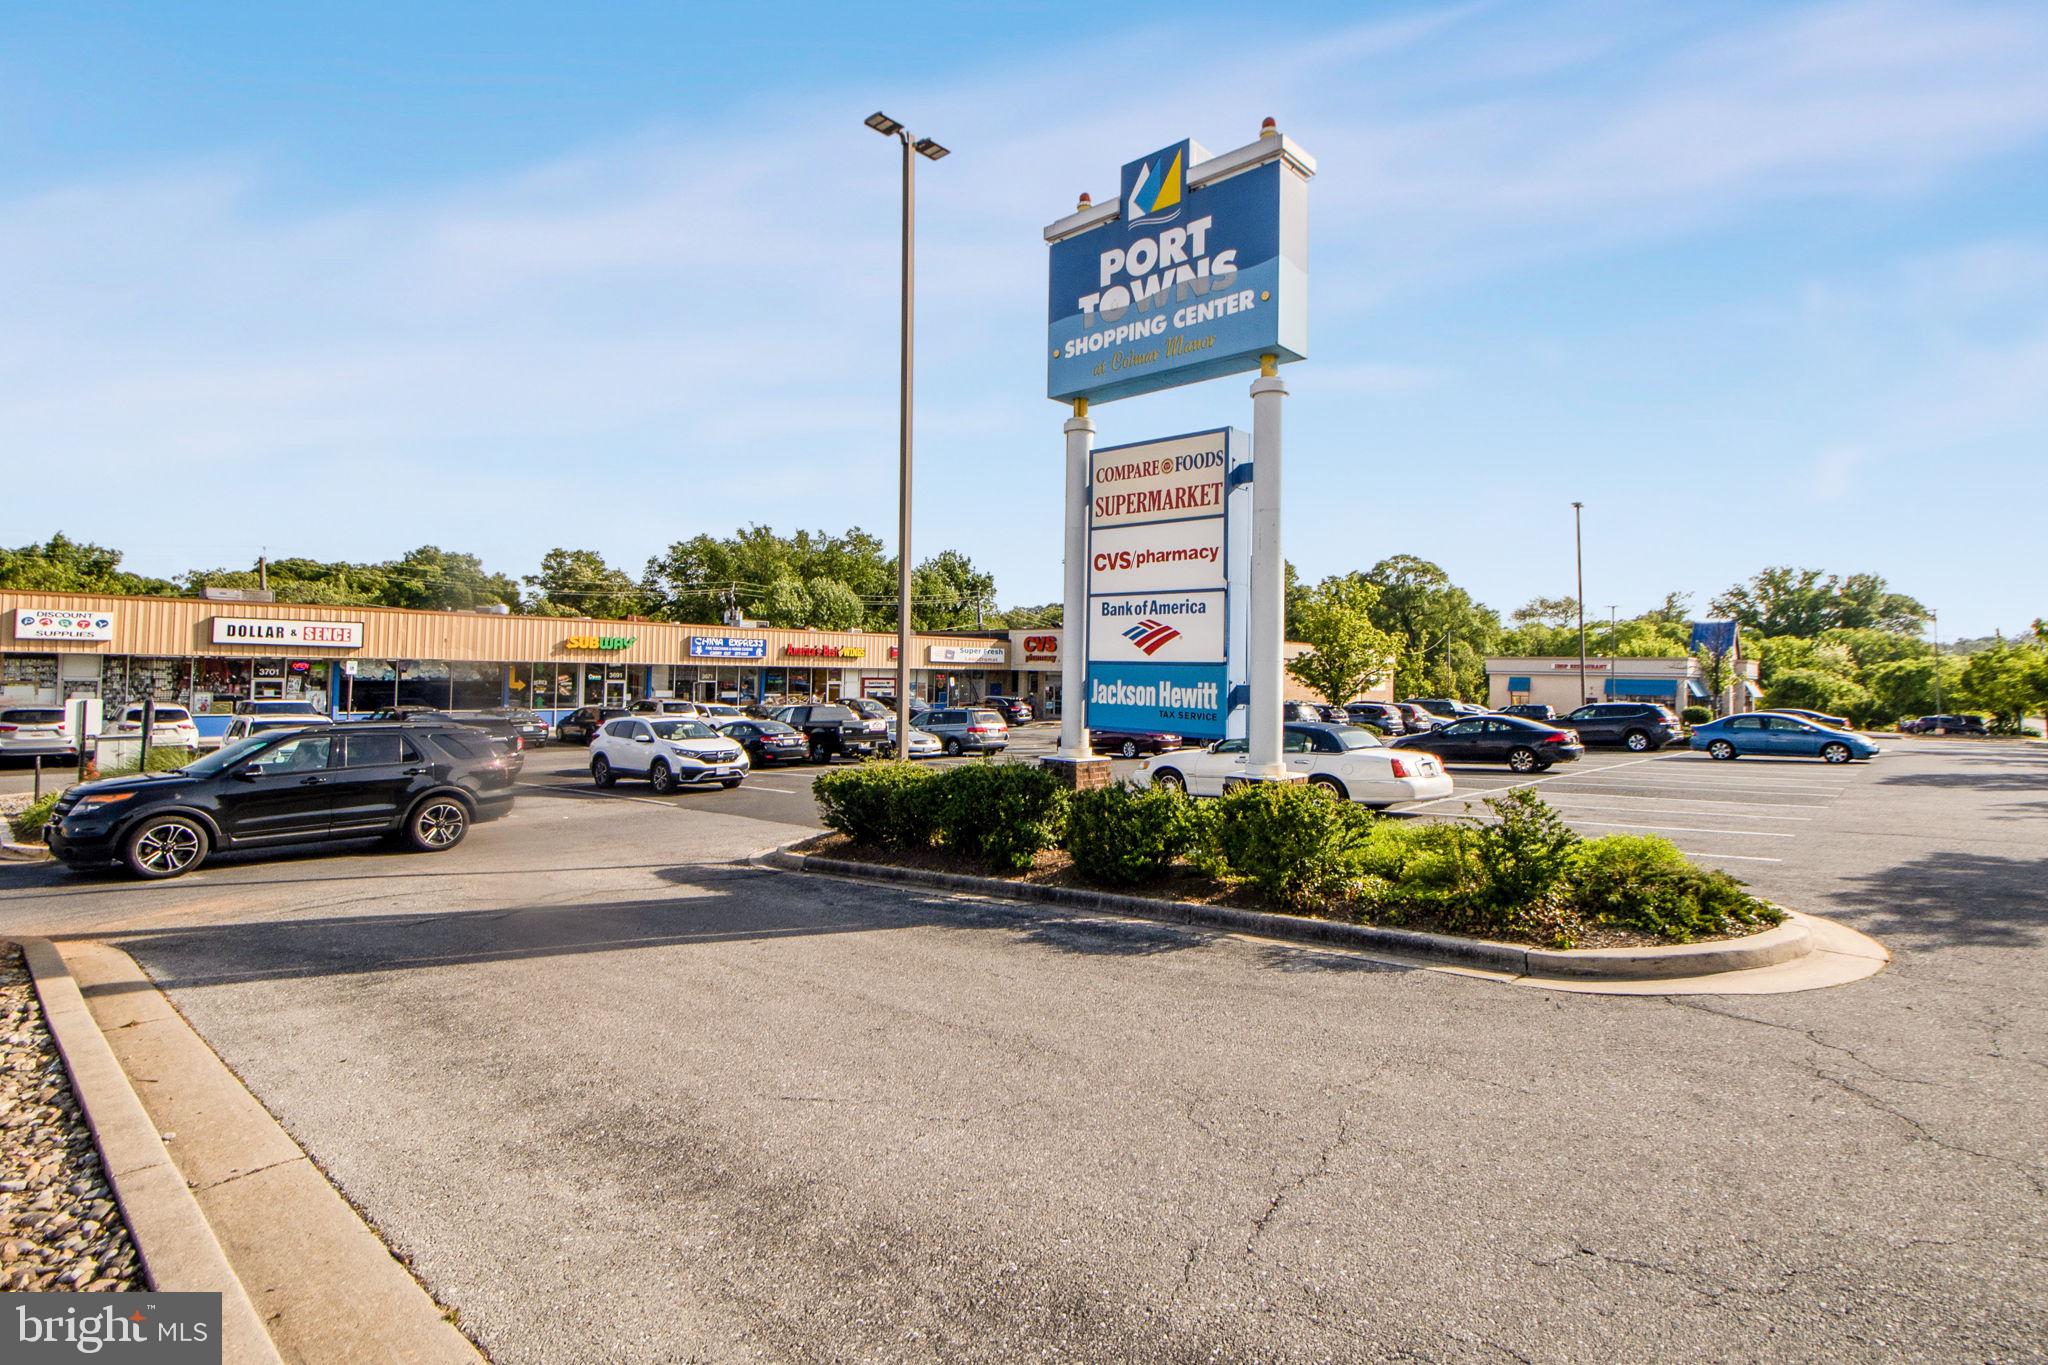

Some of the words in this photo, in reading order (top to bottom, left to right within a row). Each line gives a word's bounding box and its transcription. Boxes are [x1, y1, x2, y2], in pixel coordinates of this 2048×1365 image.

[1100, 215, 1212, 287] PORT
[1078, 249, 1239, 329] TOWNS
[1064, 314, 1167, 359] SHOPPING
[1173, 289, 1255, 329] CENTER
[1092, 360, 1106, 377] at
[1111, 348, 1159, 372] Colmar
[1166, 335, 1217, 359] Manor
[1095, 460, 1160, 483] COMPARE
[1175, 449, 1224, 472] FOODS
[1095, 482, 1224, 518] SUPERMARKET
[1093, 546, 1220, 572] CVS/pharmacy
[36, 611, 94, 619] DISCOUNT
[1101, 601, 1133, 616] Bank
[1134, 600, 1149, 616] of
[1149, 598, 1206, 615] America
[36, 630, 95, 638] SUPPLIES
[226, 624, 285, 639] DOLLAR
[290, 629, 297, 637] &
[304, 627, 351, 642] SENCE
[566, 636, 637, 650] SUBWAY
[694, 637, 724, 646] CHINA
[728, 638, 764, 648] EXPRESS
[959, 647, 982, 655] Super
[1023, 635, 1058, 653] CVS
[259, 668, 279, 676] 3701
[292, 662, 309, 670] OPEN
[1091, 678, 1156, 706] Jackson
[1159, 680, 1218, 710] Hewitt
[1159, 710, 1175, 719] TAX
[1177, 711, 1217, 721] SERVICE
